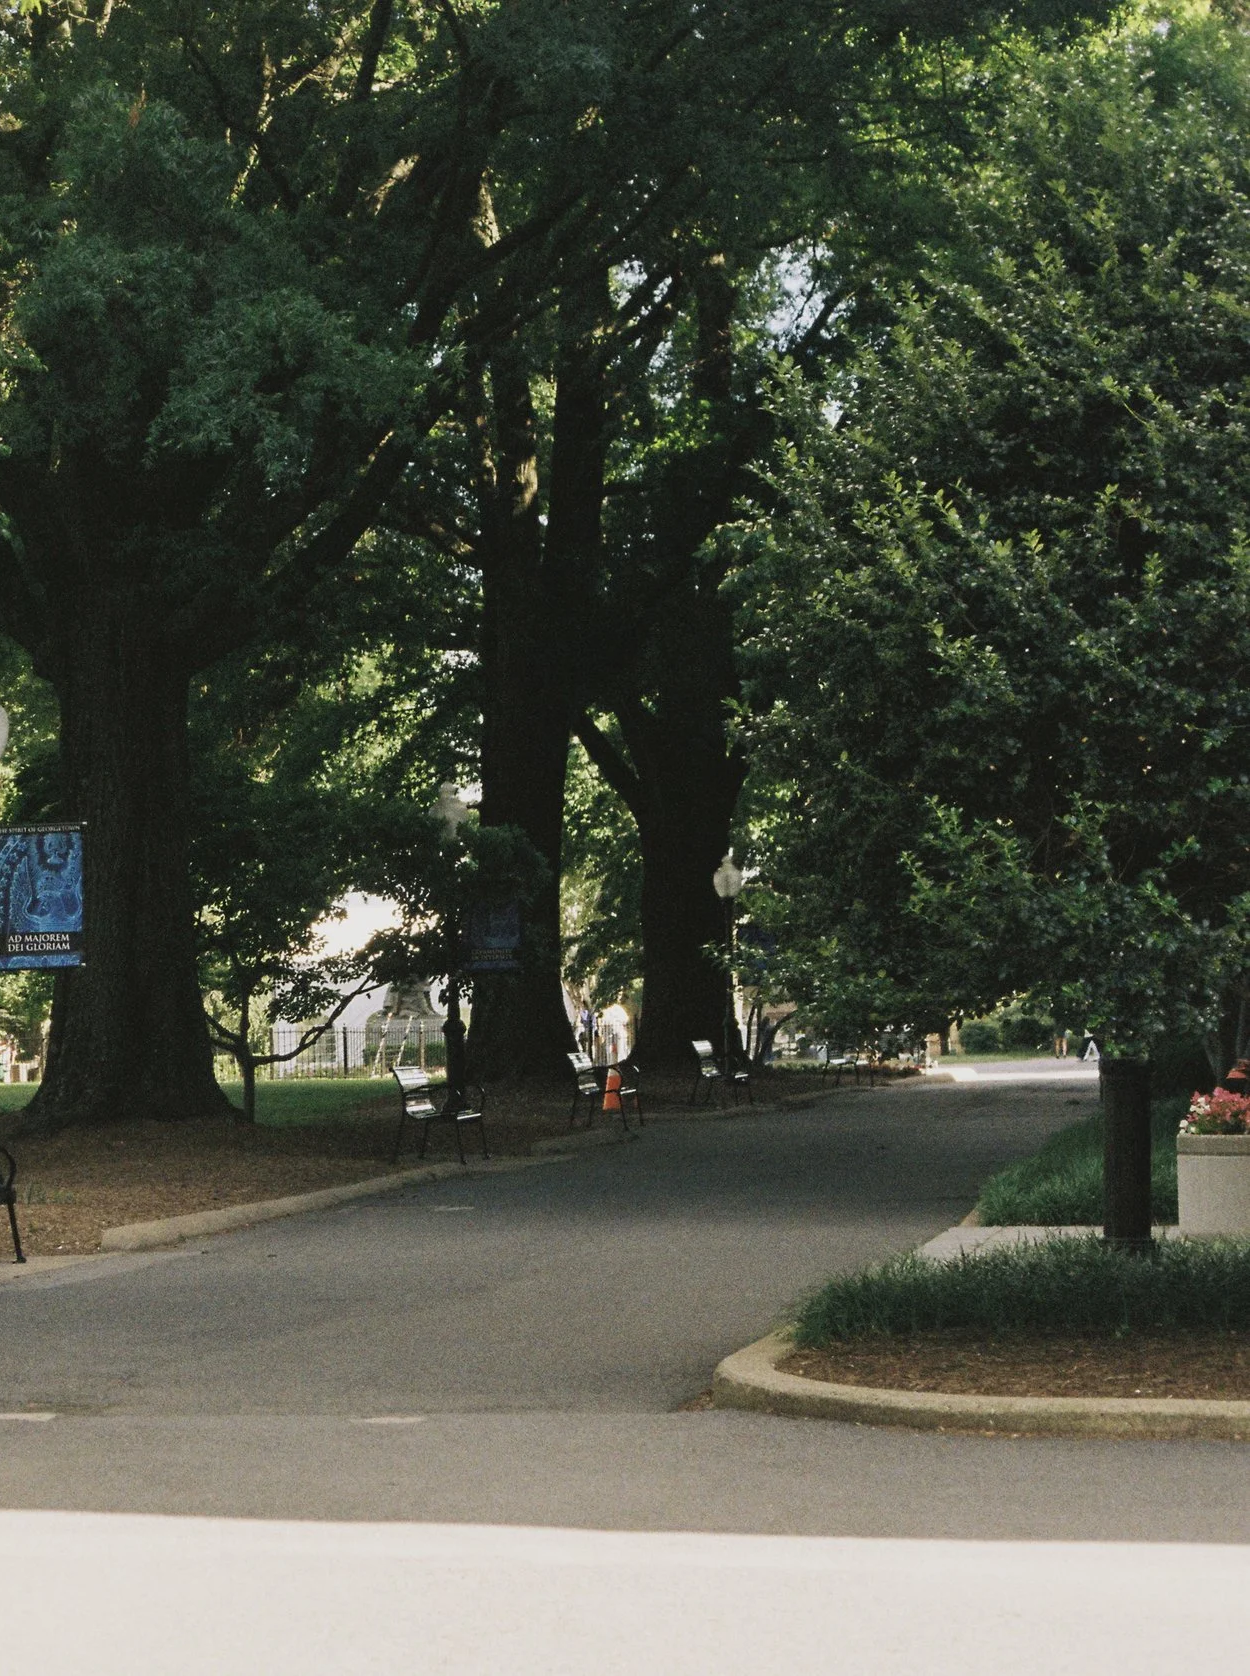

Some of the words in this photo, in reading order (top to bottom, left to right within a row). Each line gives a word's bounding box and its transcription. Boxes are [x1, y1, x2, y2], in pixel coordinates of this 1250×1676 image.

[8, 935, 22, 943] AD
[24, 933, 70, 943] MAJOREM
[8, 944, 24, 952] DEI
[26, 942, 70, 951] GLORIAM
